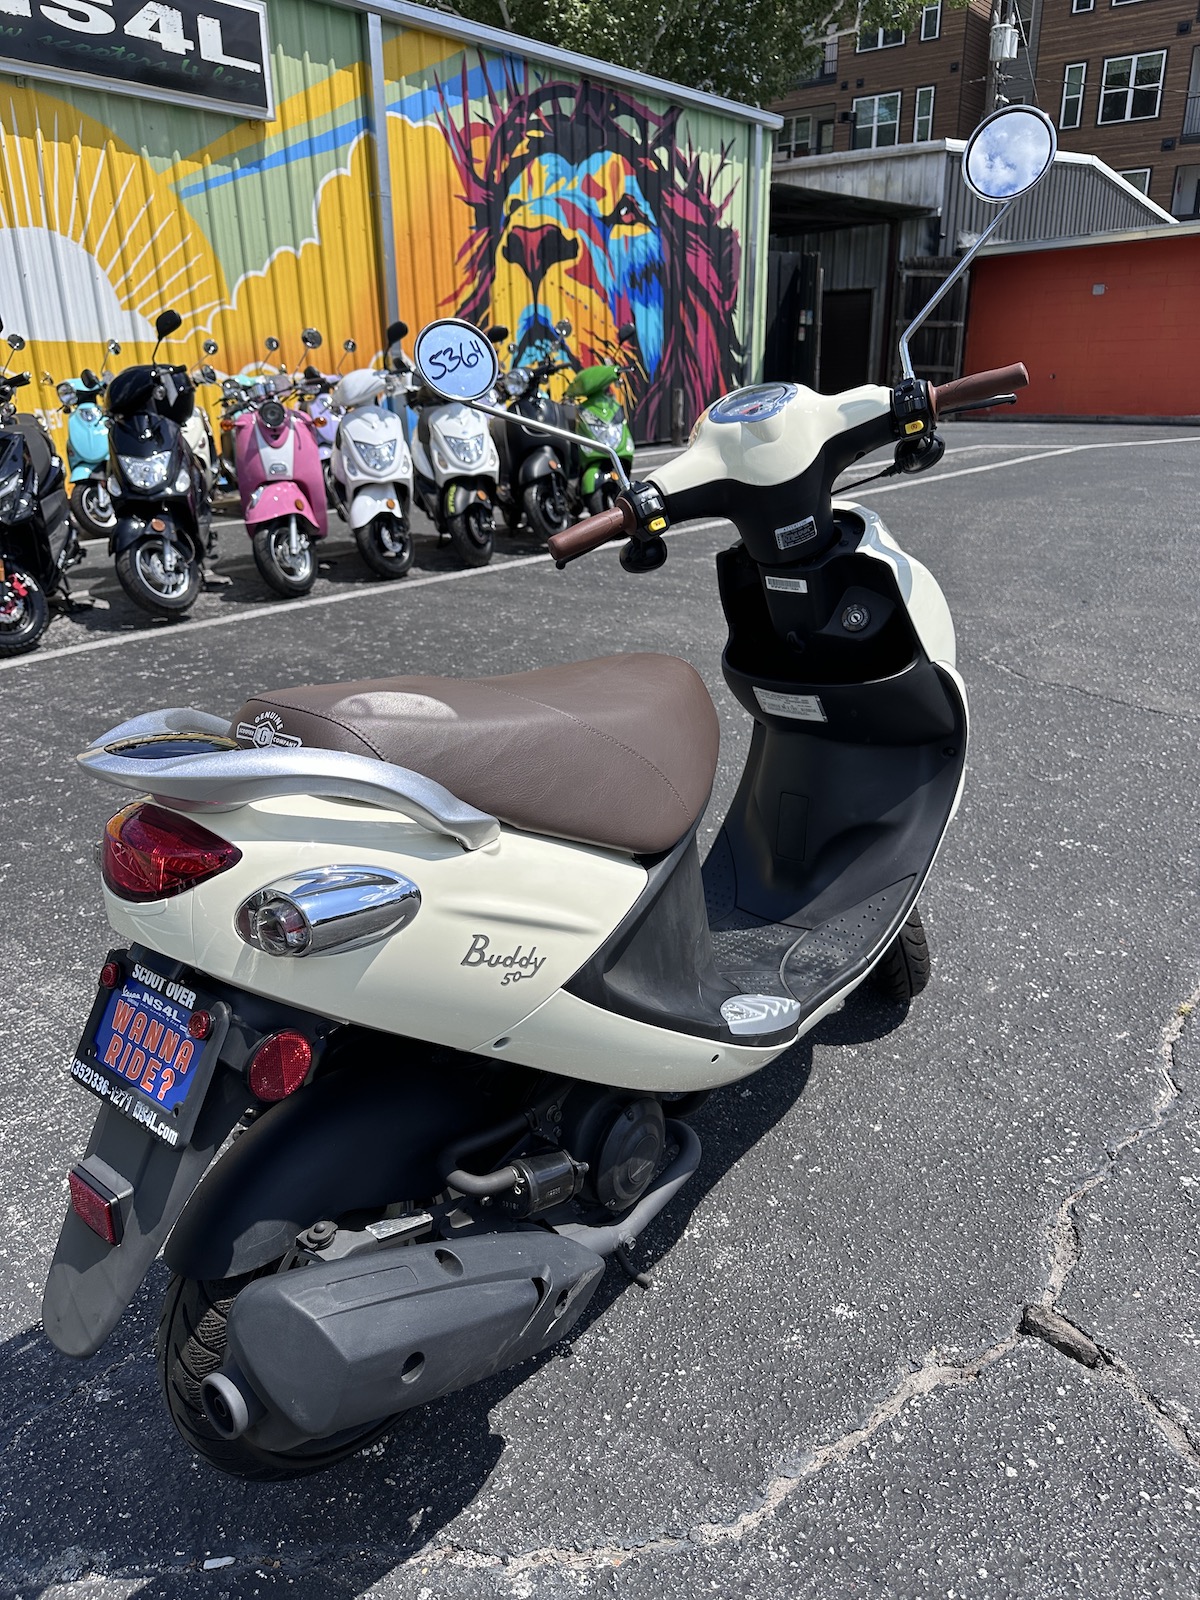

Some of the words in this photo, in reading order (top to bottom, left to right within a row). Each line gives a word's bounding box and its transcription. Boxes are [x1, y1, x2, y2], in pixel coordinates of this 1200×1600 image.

[428, 340, 485, 381] 5364
[254, 711, 284, 731] GENUINE
[460, 934, 547, 978] Buddy
[131, 963, 167, 992] SCOOT
[165, 981, 198, 1010] OVER
[500, 971, 522, 986] 50
[142, 992, 182, 1024] NS4L
[111, 999, 195, 1074] WANNA
[103, 1033, 176, 1101] RIDE?
[132, 1101, 179, 1146] NS4L.com
